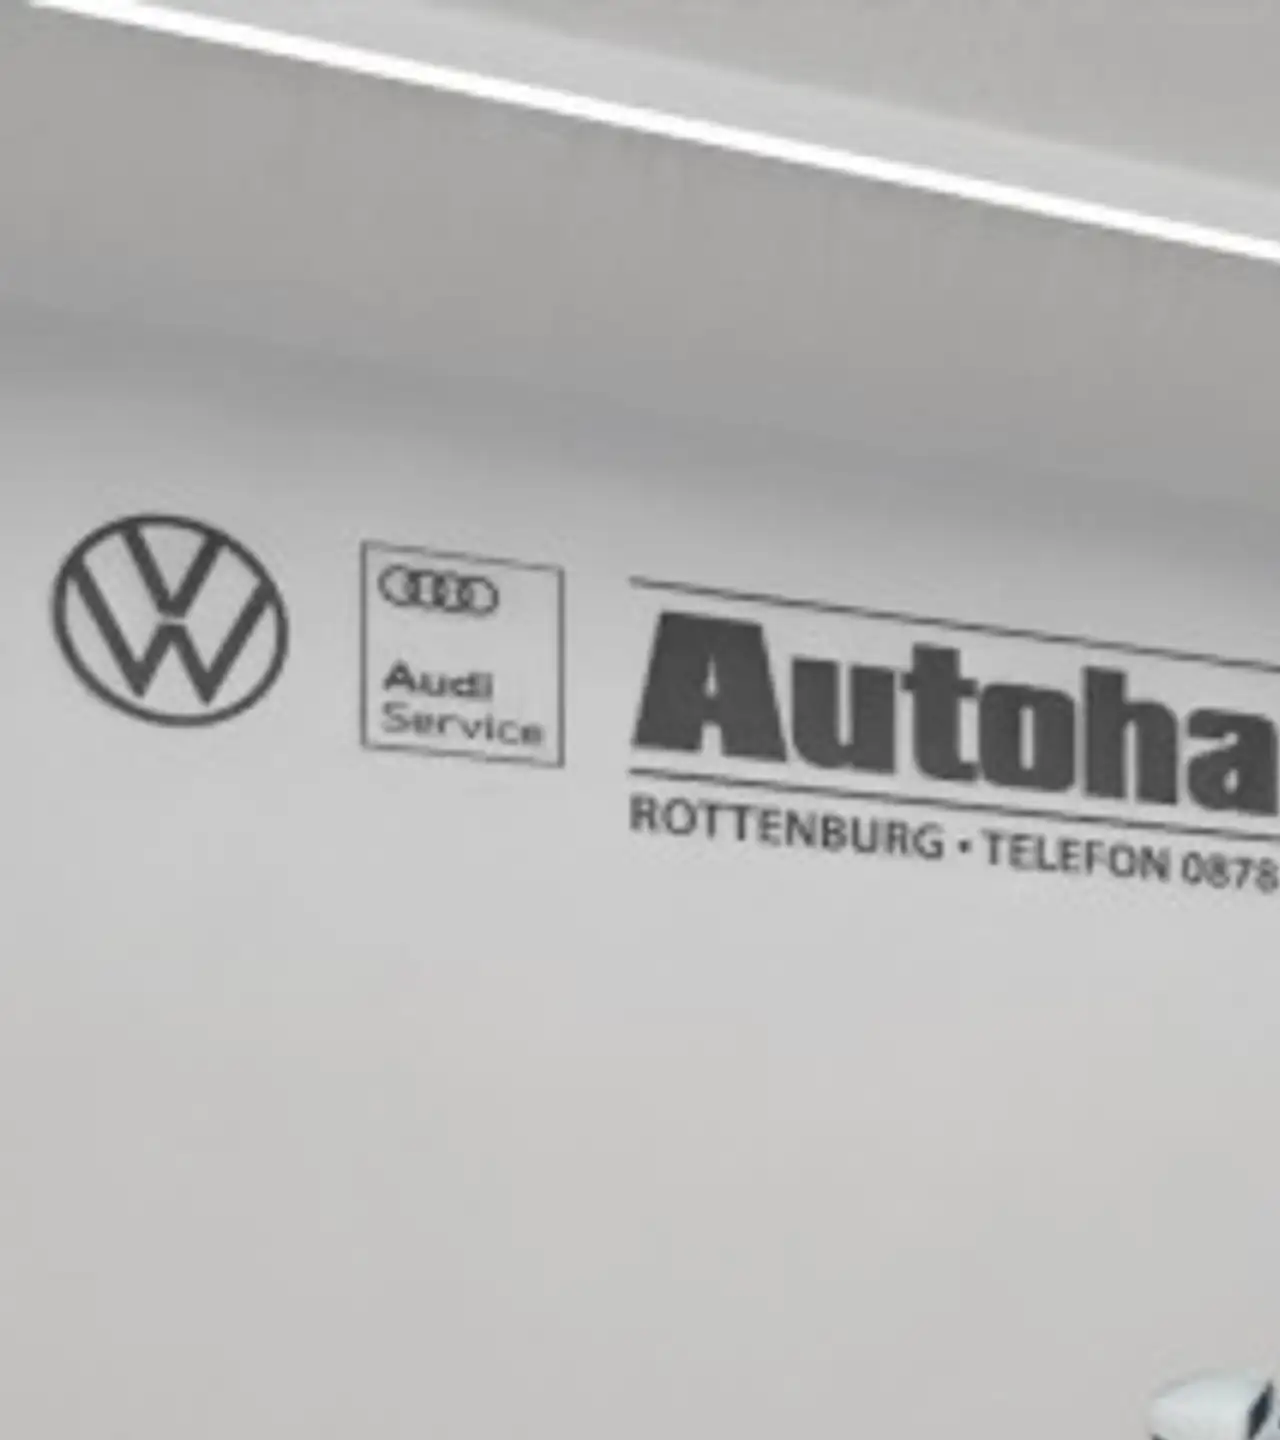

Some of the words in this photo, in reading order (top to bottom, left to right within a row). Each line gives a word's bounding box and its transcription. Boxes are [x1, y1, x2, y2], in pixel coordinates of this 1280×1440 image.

[382, 657, 494, 701] Audi
[382, 700, 545, 747] Service
[627, 792, 944, 861] ROTTENBURG
[980, 827, 1172, 885] TELEFON
